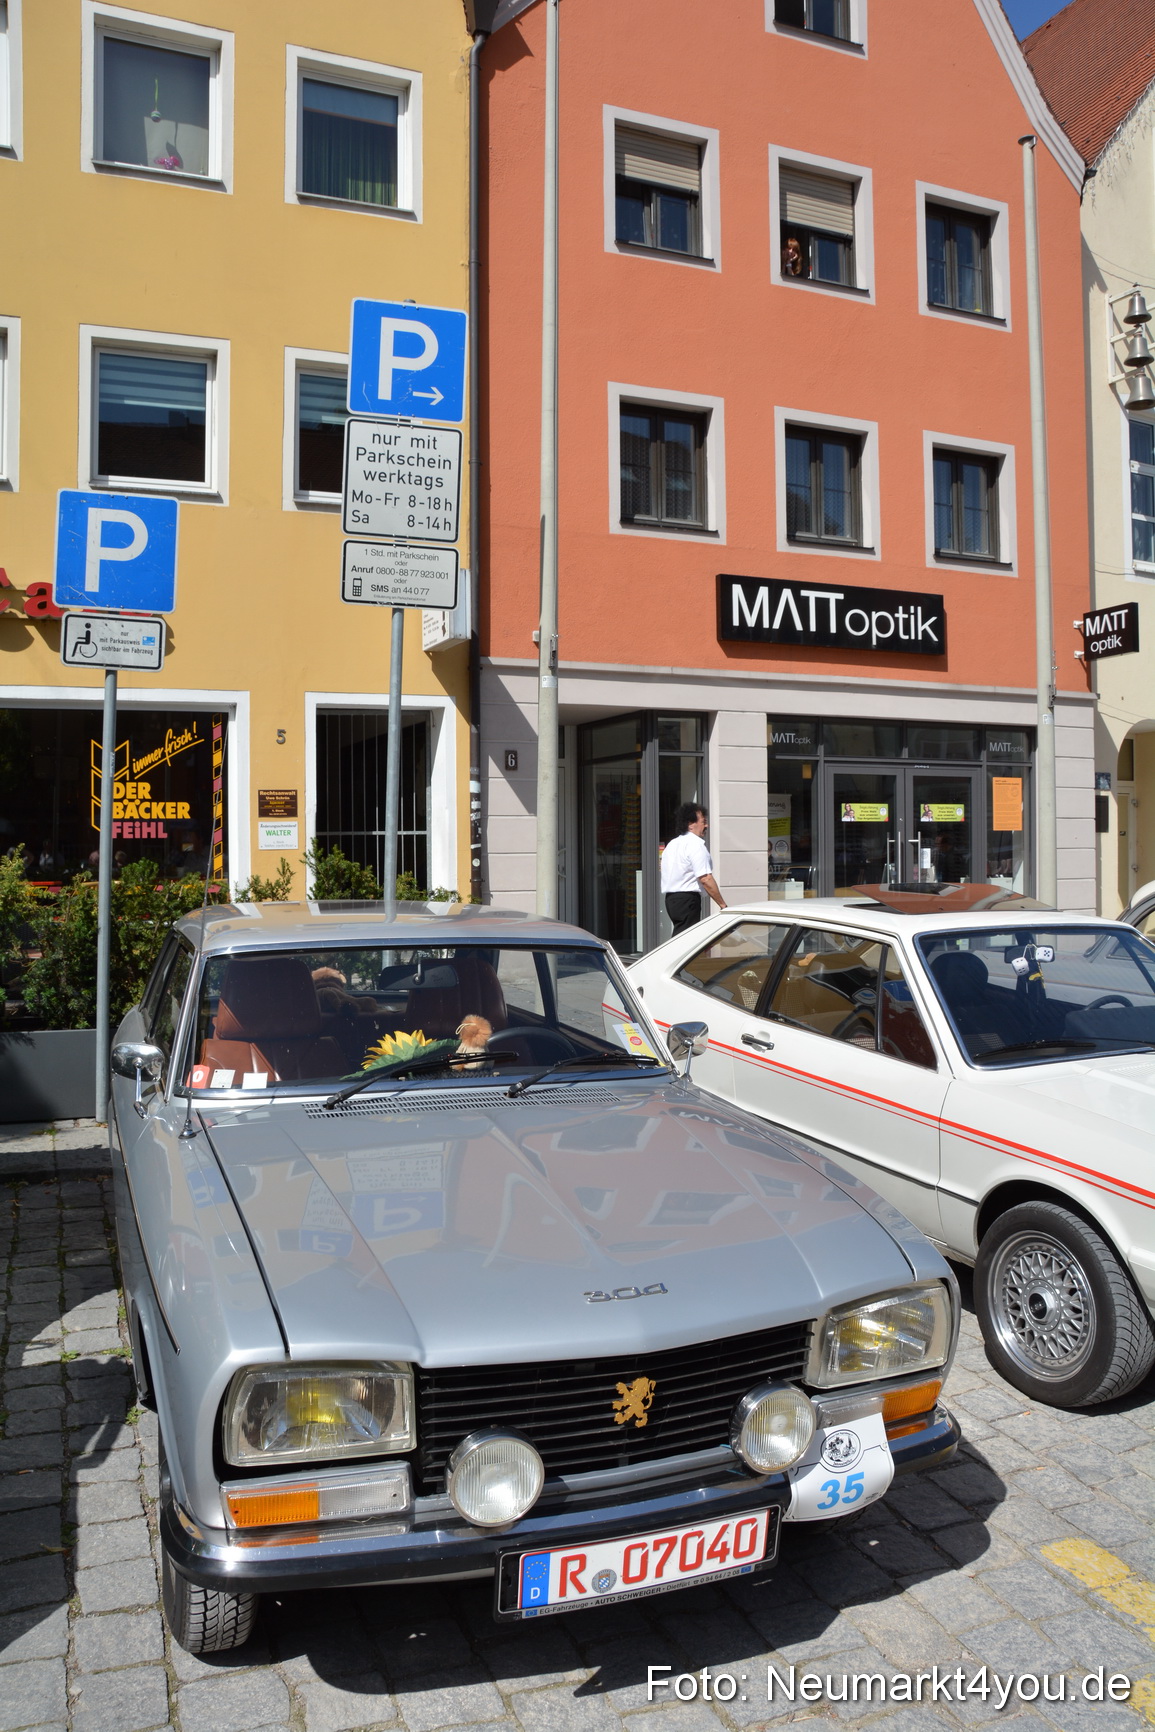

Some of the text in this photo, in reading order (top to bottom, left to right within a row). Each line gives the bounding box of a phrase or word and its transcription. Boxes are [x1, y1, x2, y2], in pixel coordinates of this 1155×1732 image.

[378, 316, 439, 401] P
[372, 433, 438, 450] nur mit
[356, 446, 452, 470] Parkschein
[363, 469, 444, 490] werktags
[351, 509, 370, 524] Sa
[84, 507, 149, 593] P
[371, 548, 385, 557] Std.
[400, 551, 439, 561] Parkschein
[351, 564, 374, 574] Anruf
[370, 584, 390, 592] SMS
[1085, 609, 1128, 637] MATT
[131, 648, 154, 656] Fahrzeug
[1090, 634, 1122, 654] optik
[276, 729, 286, 745] 5
[132, 746, 164, 774] immer
[508, 753, 516, 767] 6
[113, 782, 152, 799] DER
[112, 799, 191, 819] BÄCKER
[583, 1282, 668, 1304] 304
[817, 1472, 864, 1510] 35
[559, 1518, 758, 1598] R 07040
[530, 1588, 540, 1600] D
[540, 1602, 588, 1614] EG-Fahrzeuge
[594, 1596, 616, 1605] AUTO
[617, 1588, 660, 1600] SCHWEIGER
